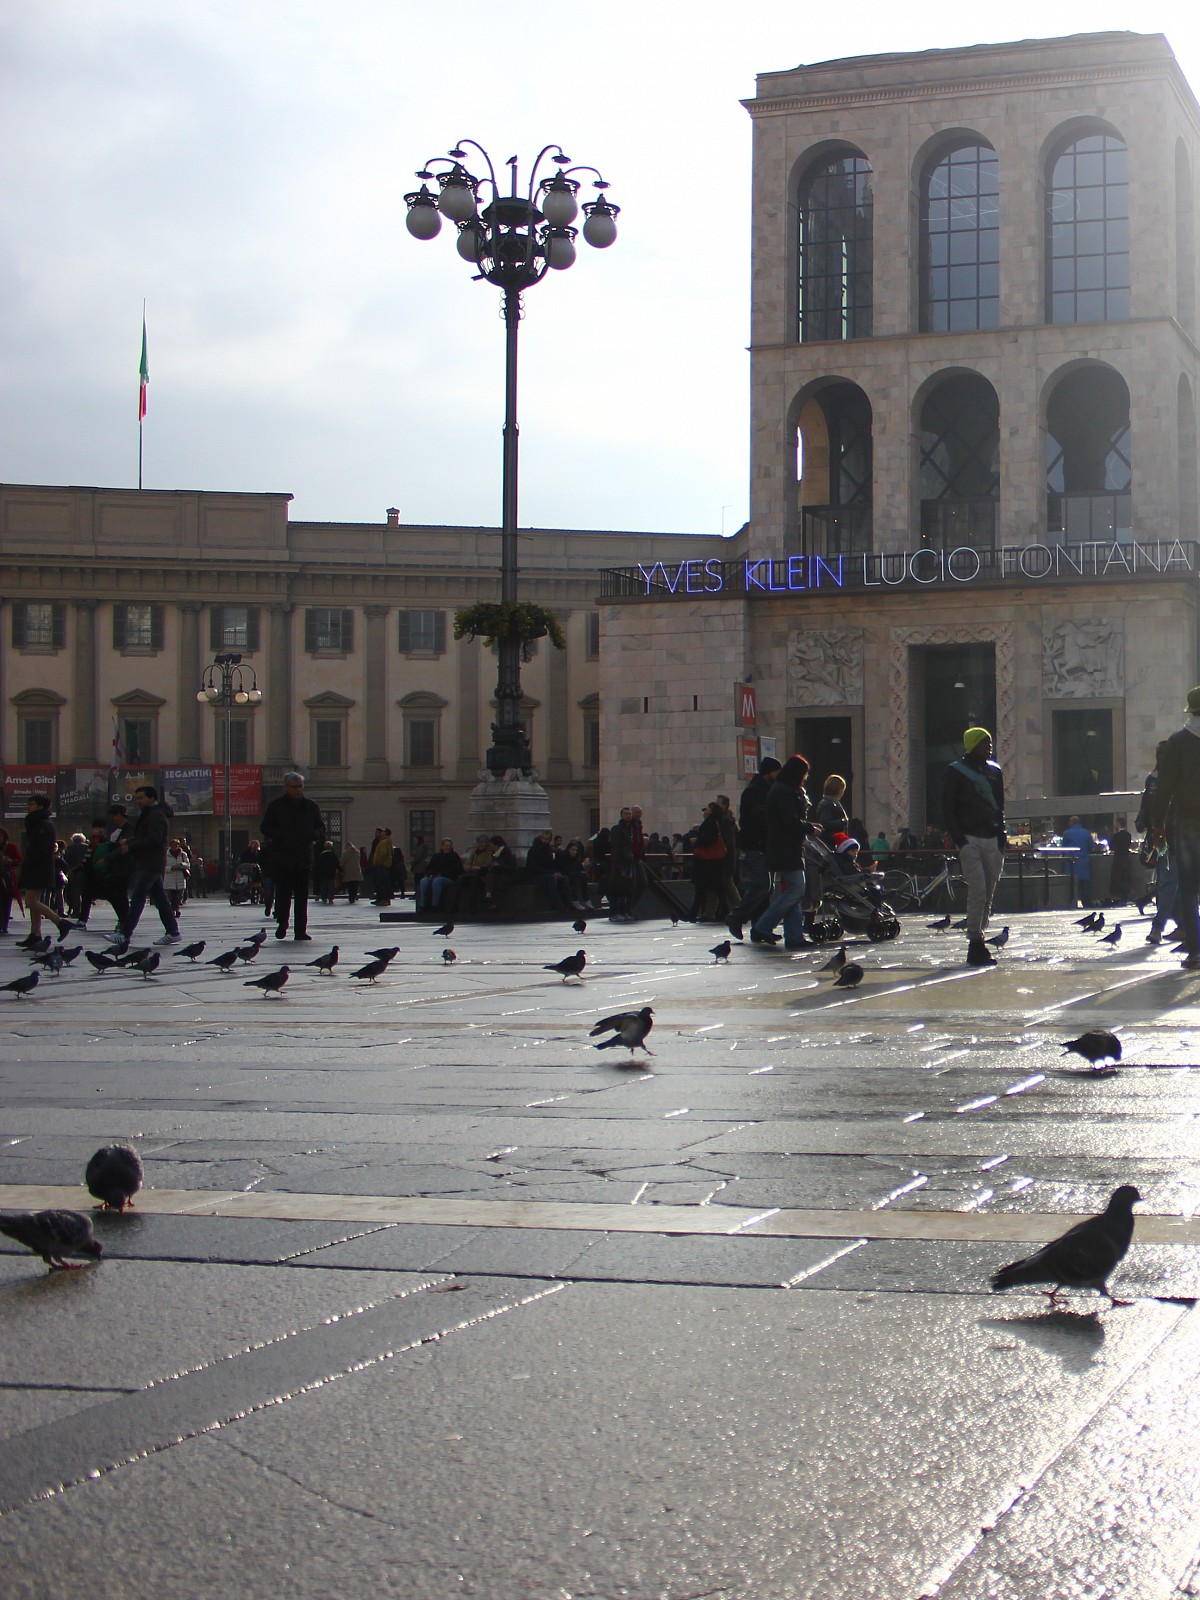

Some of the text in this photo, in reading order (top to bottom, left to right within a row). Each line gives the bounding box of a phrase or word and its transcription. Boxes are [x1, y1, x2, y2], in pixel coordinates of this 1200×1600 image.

[637, 538, 1193, 596] YVES KLEIN LUCIO FONTANA
[742, 693, 755, 719] M
[5, 775, 57, 784] Amos Gitai
[165, 769, 212, 779] SEGANTINI
[60, 793, 91, 806] CHAGALL
